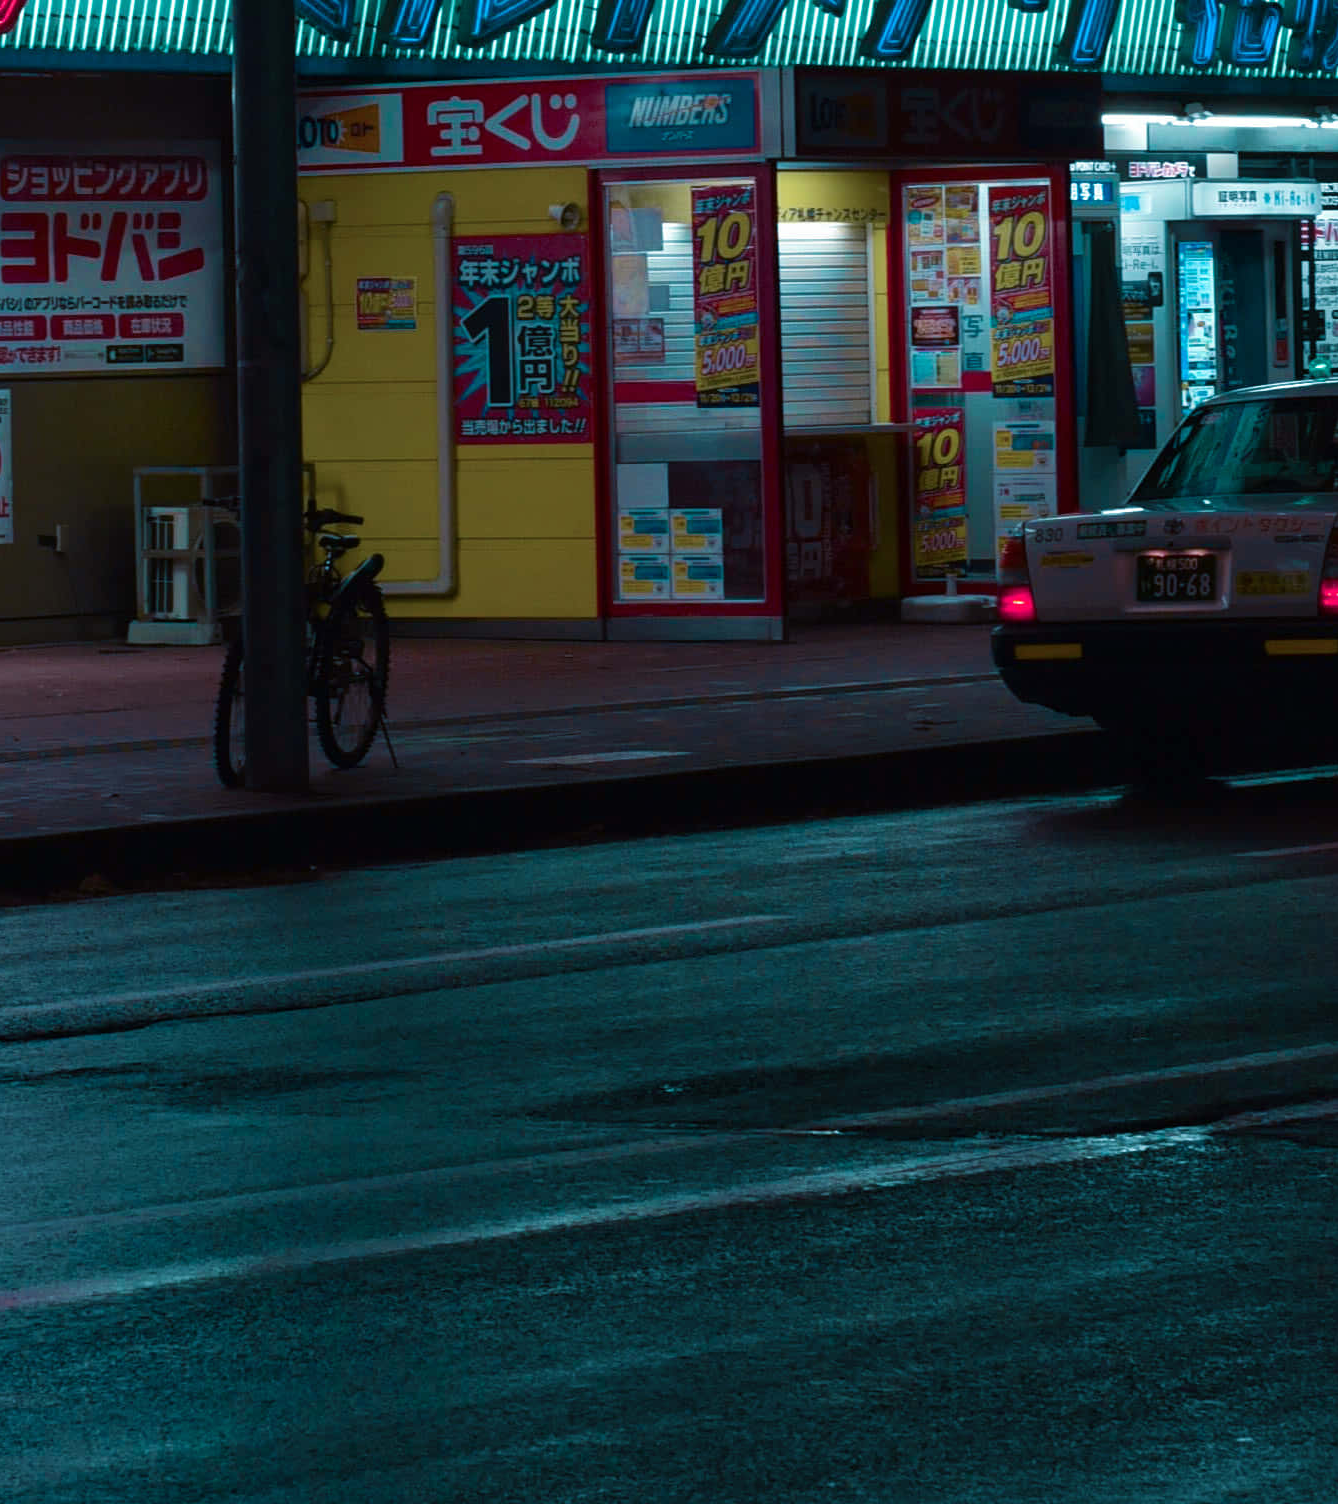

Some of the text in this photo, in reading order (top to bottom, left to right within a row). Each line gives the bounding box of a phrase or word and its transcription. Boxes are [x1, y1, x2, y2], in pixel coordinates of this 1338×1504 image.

[426, 93, 582, 157] 宝くじ
[630, 93, 732, 129] NUMBERS
[297, 115, 340, 149] OTO
[5, 158, 205, 197] ショッピングアプリ
[1217, 190, 1258, 203] 証明写真
[0, 211, 206, 284] ヨドバシ
[696, 211, 752, 265] 10
[993, 210, 1047, 262] 10
[458, 256, 582, 288] 年末ジャンボ
[698, 258, 751, 297] 億円
[994, 256, 1047, 293] 億円
[516, 294, 556, 321] 2等
[460, 293, 516, 408] 1
[517, 323, 556, 395] 億円
[916, 427, 960, 468] 10
[1035, 527, 1063, 543] 830
[1153, 572, 1212, 599] 90-68
